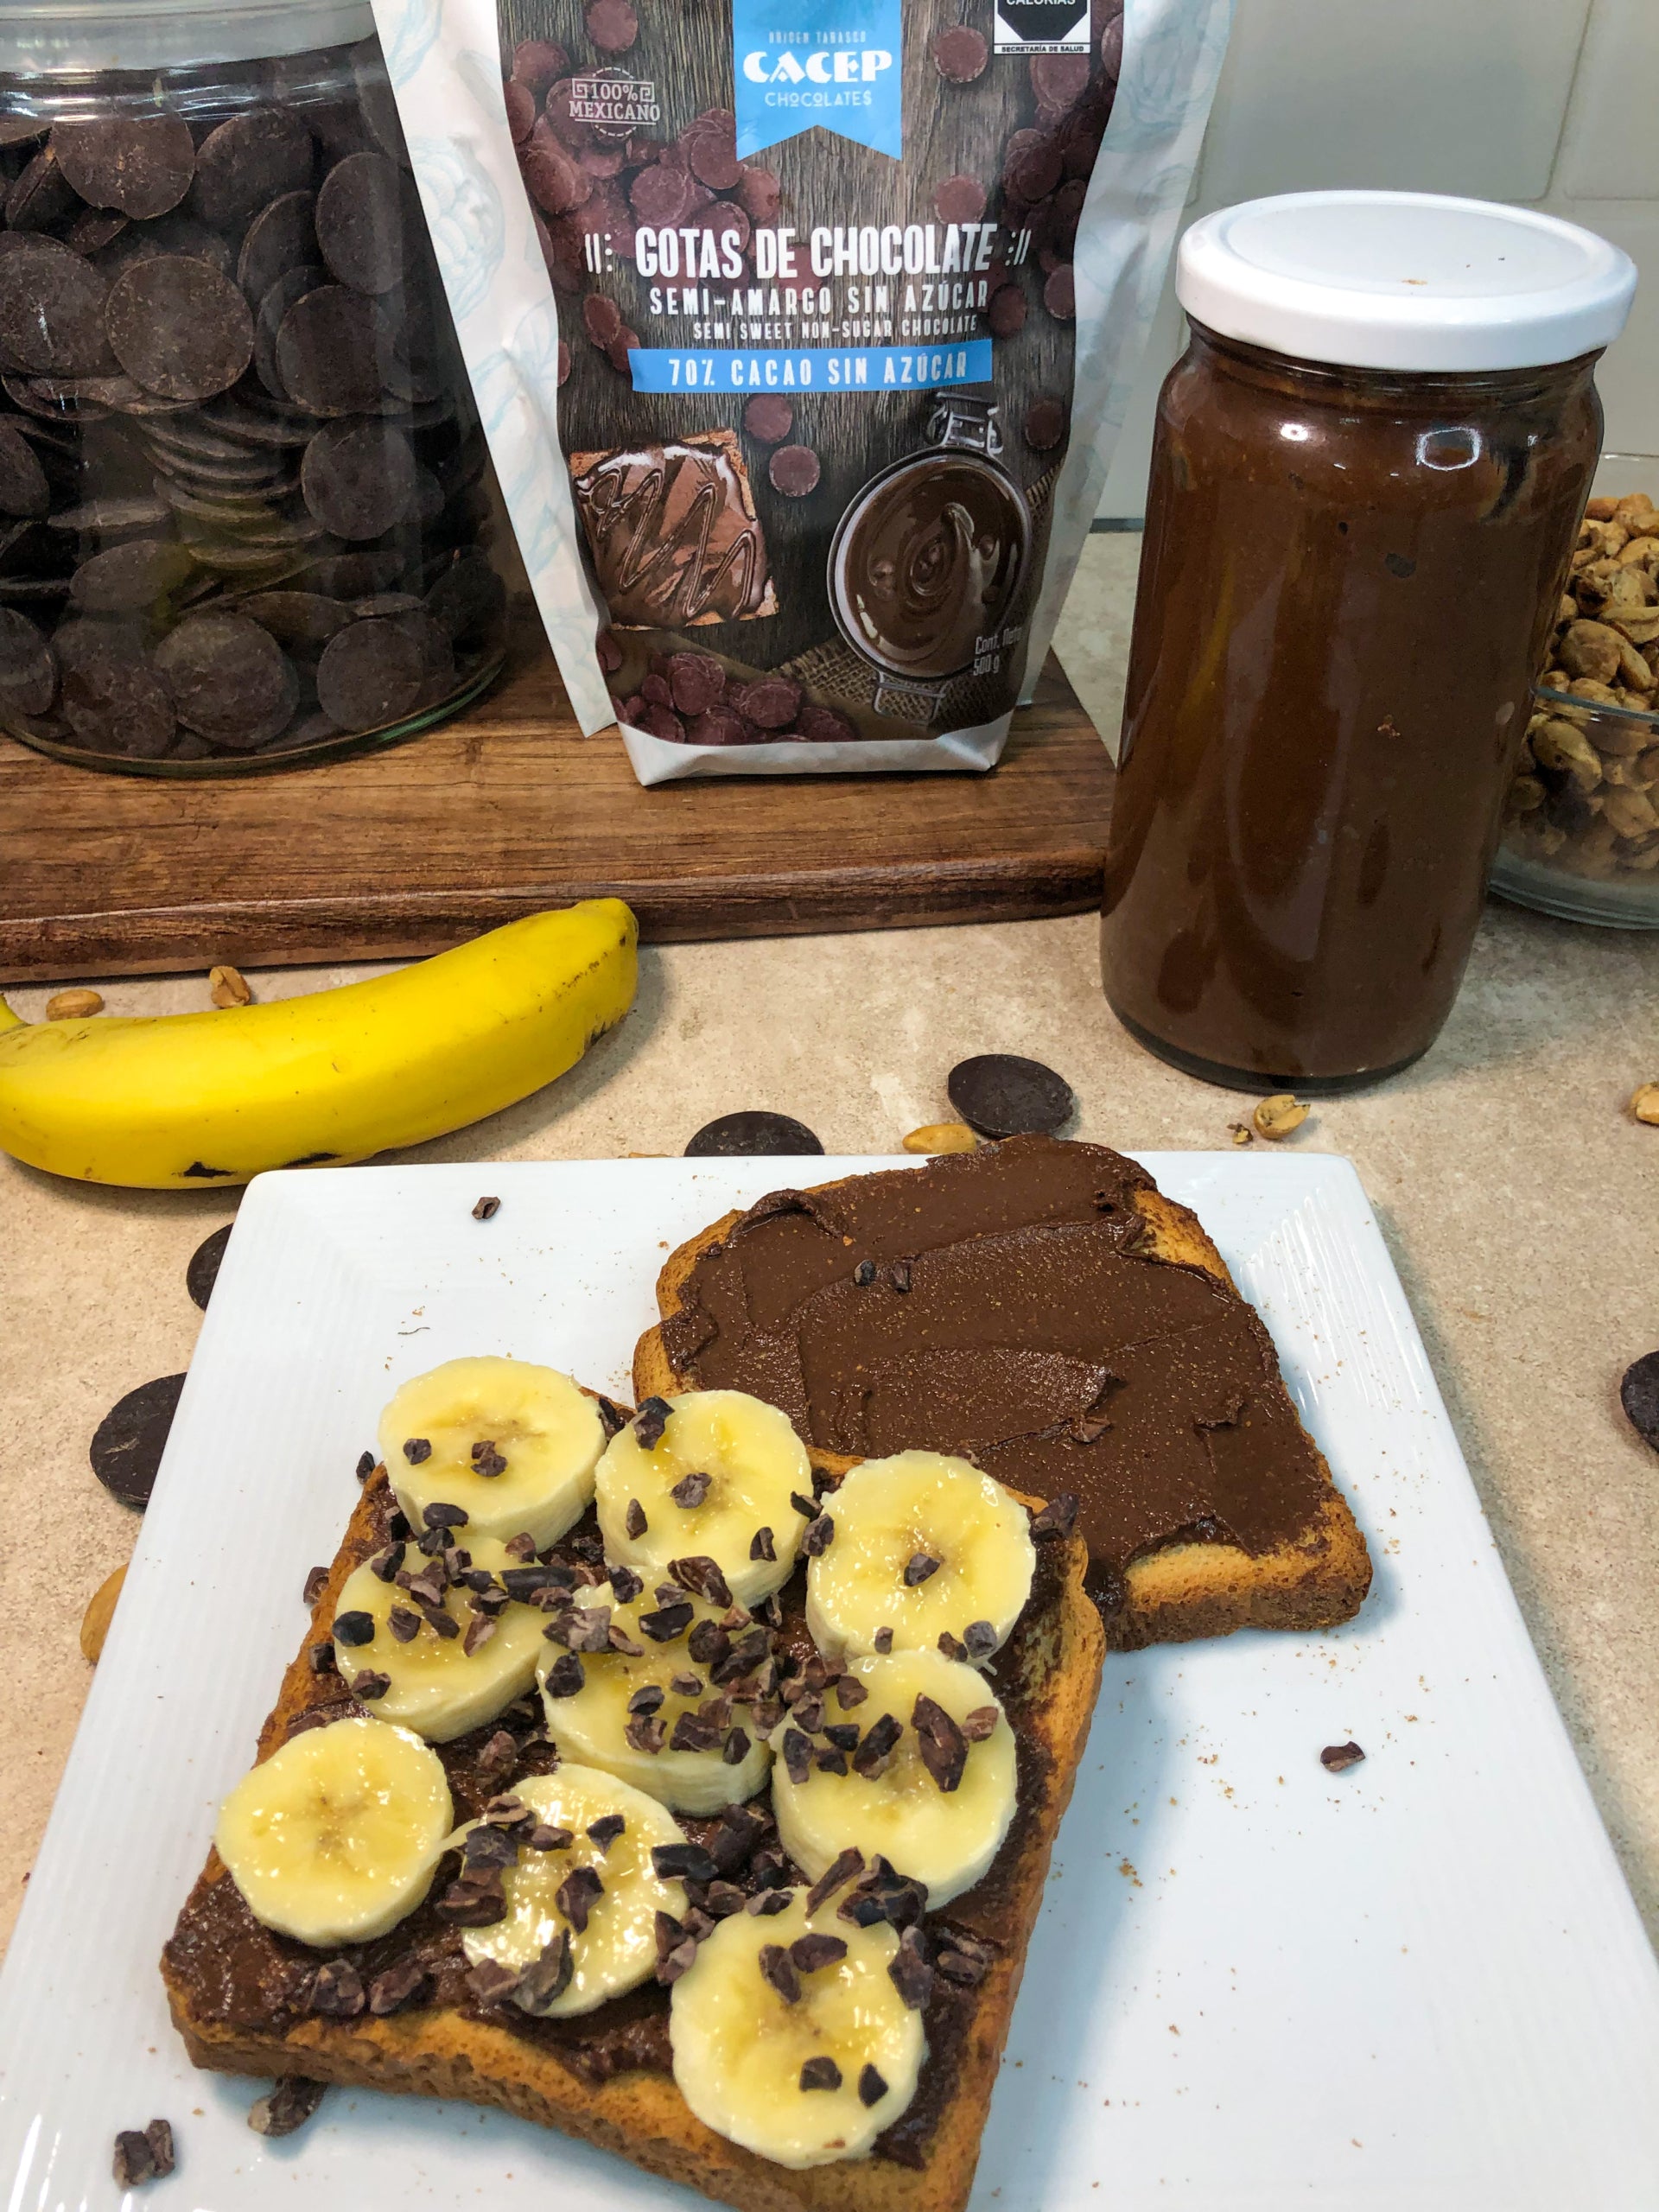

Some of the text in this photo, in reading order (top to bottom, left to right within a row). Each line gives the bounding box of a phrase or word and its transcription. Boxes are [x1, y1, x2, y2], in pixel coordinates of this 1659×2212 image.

[742, 50, 893, 85] CACEP
[591, 83, 639, 101] 100%
[765, 90, 873, 107] CHOCOLATES
[569, 100, 661, 121] MEXICANO
[635, 223, 997, 279] GOTAS DE CHOCOLATE
[650, 280, 988, 316] SEMI-AMARGO SIN AZÚCAR
[693, 315, 977, 340] SEMI SWEET NON-SUGAR CHOCOLATE
[668, 351, 967, 386] 70% CACAO SIN AZÚCAR
